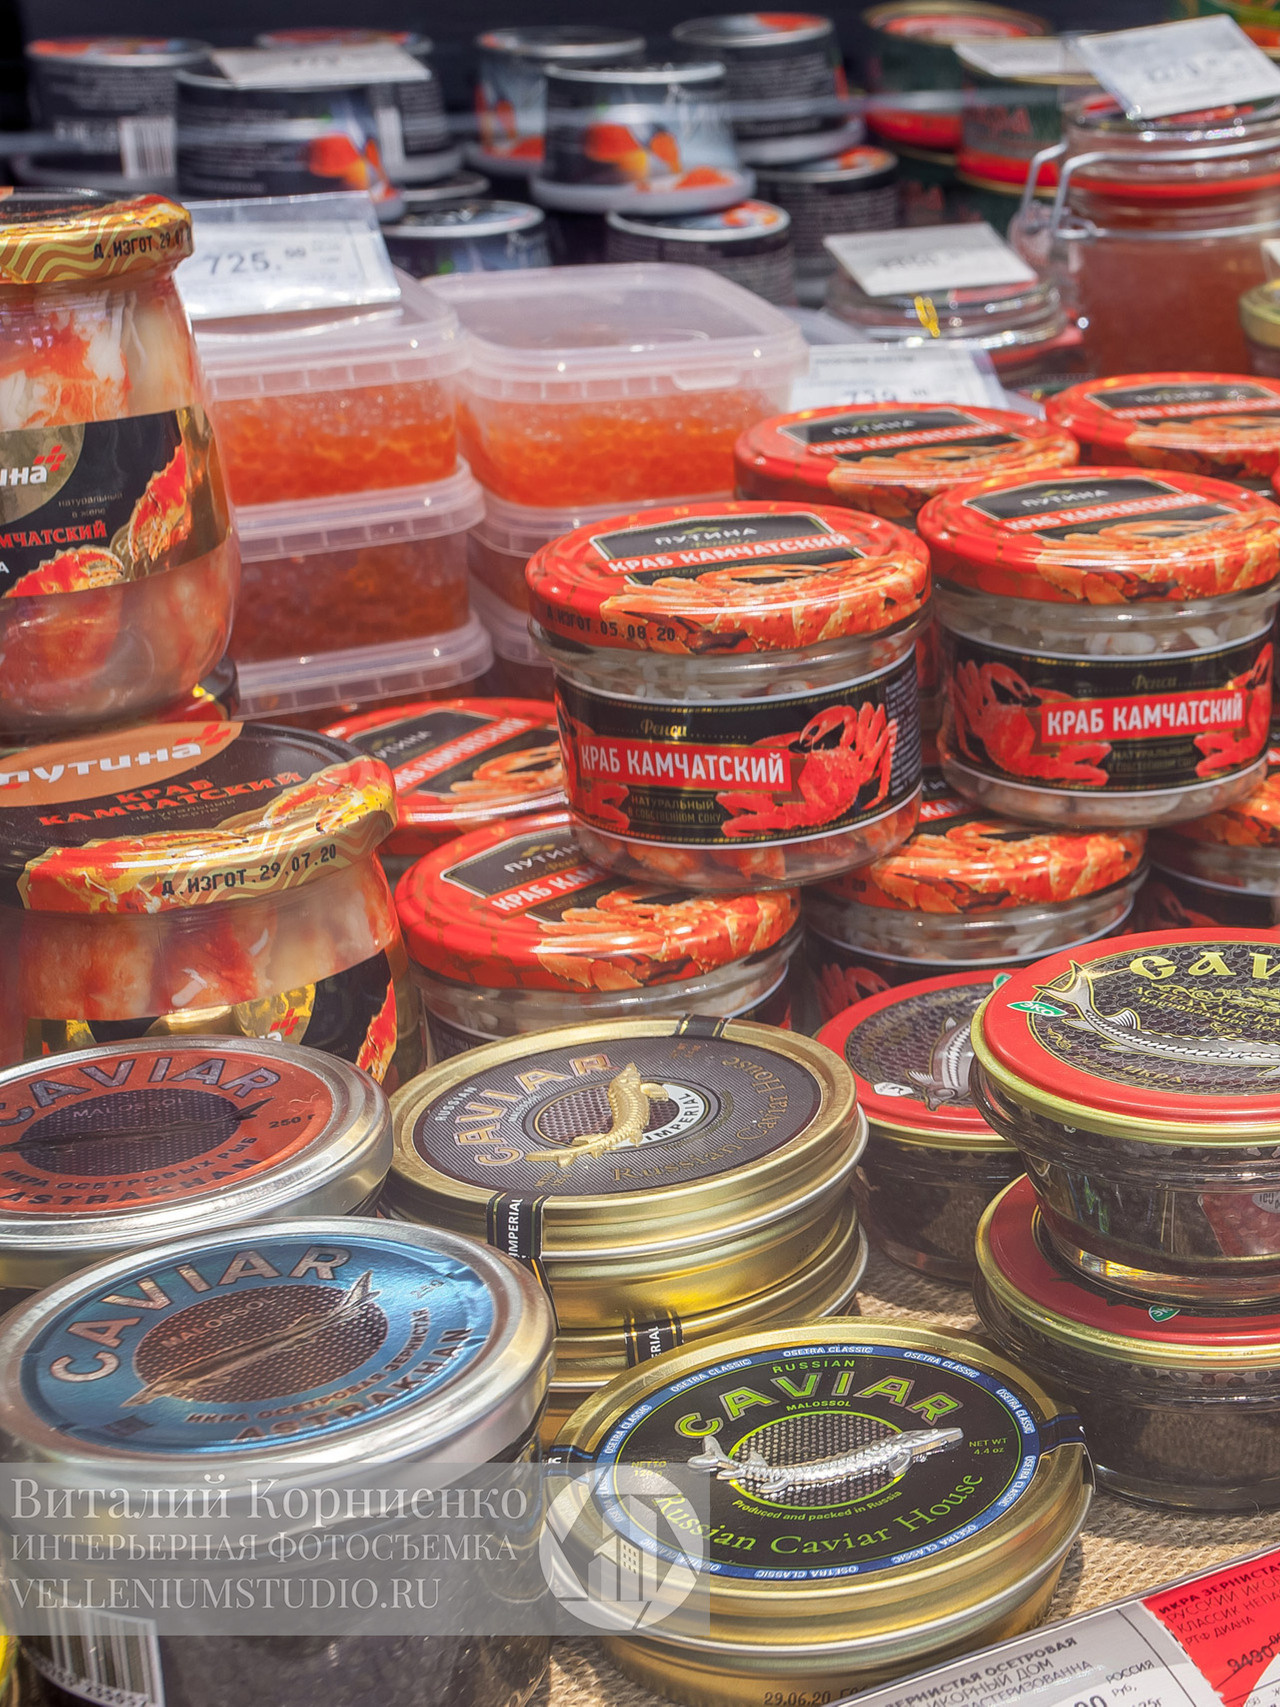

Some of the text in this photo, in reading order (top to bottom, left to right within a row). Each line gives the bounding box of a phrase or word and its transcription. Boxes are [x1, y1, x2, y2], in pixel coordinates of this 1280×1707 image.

[608, 555, 674, 573] КРАБ
[682, 533, 852, 564] КАМЧАТСКИЙ
[1047, 692, 1244, 736] КРАБ КАМЧАТСКИЙ
[581, 744, 786, 785] КРАБ КАМЧАТСКИЙ
[39, 771, 303, 827] КАМЧАТСКИЙ
[116, 778, 215, 804] КРАБ
[491, 883, 553, 912] КРАБ
[1018, 1000, 1056, 1018] ЭКО
[73, 1097, 184, 1118] MALOSSOL
[268, 1115, 303, 1129] 250
[435, 1086, 478, 1122] RUSSIAN
[453, 1053, 621, 1166] CAVIAR
[612, 1056, 789, 1182] Russian Caviar House
[644, 1092, 700, 1141] IMPERIAL
[57, 1159, 215, 1190] ОСЕТРОВЫХ
[219, 1136, 259, 1160] РЫБ
[508, 1198, 523, 1258] IMPERIAL
[50, 1246, 352, 1383] CAVIAR
[161, 1296, 277, 1349] MALOSSOL
[772, 1359, 855, 1374] RUSSIAN
[783, 1345, 874, 1357] OSETRA CLASSIC
[903, 1350, 981, 1378] OSETRA CLASSIC
[231, 1327, 474, 1444] ASTRAKHAN
[670, 1358, 752, 1393] OSETRA CLASSIC
[255, 1372, 388, 1420] ОСЕТРОВАЯ
[675, 1371, 965, 1441] CAVIAR
[786, 1400, 852, 1412] MALOSSOL
[995, 1387, 1037, 1434] OSETRA CLASSIC
[604, 1430, 622, 1454] OSETRA
[621, 1405, 652, 1430] CLASSIC
[969, 1437, 1008, 1448] NET WT
[631, 1461, 667, 1469] NETTO
[973, 1447, 991, 1455] 4.4
[998, 1455, 1037, 1508] OSETRA CLASSIC
[652, 1492, 757, 1552] Russian
[770, 1526, 893, 1556] Caviar
[894, 1473, 984, 1534] House
[731, 1490, 902, 1523] Produced and packed in Russia
[1158, 1593, 1200, 1615] ИКРА
[1177, 1606, 1240, 1633] КЛАССИК
[1184, 1617, 1256, 1647] РТФ ДИАНА
[985, 1637, 1078, 1678] ОСЕТРОВАЯ
[1014, 1659, 1055, 1683] ДОМ
[1104, 1658, 1156, 1685] РОССИЯ
